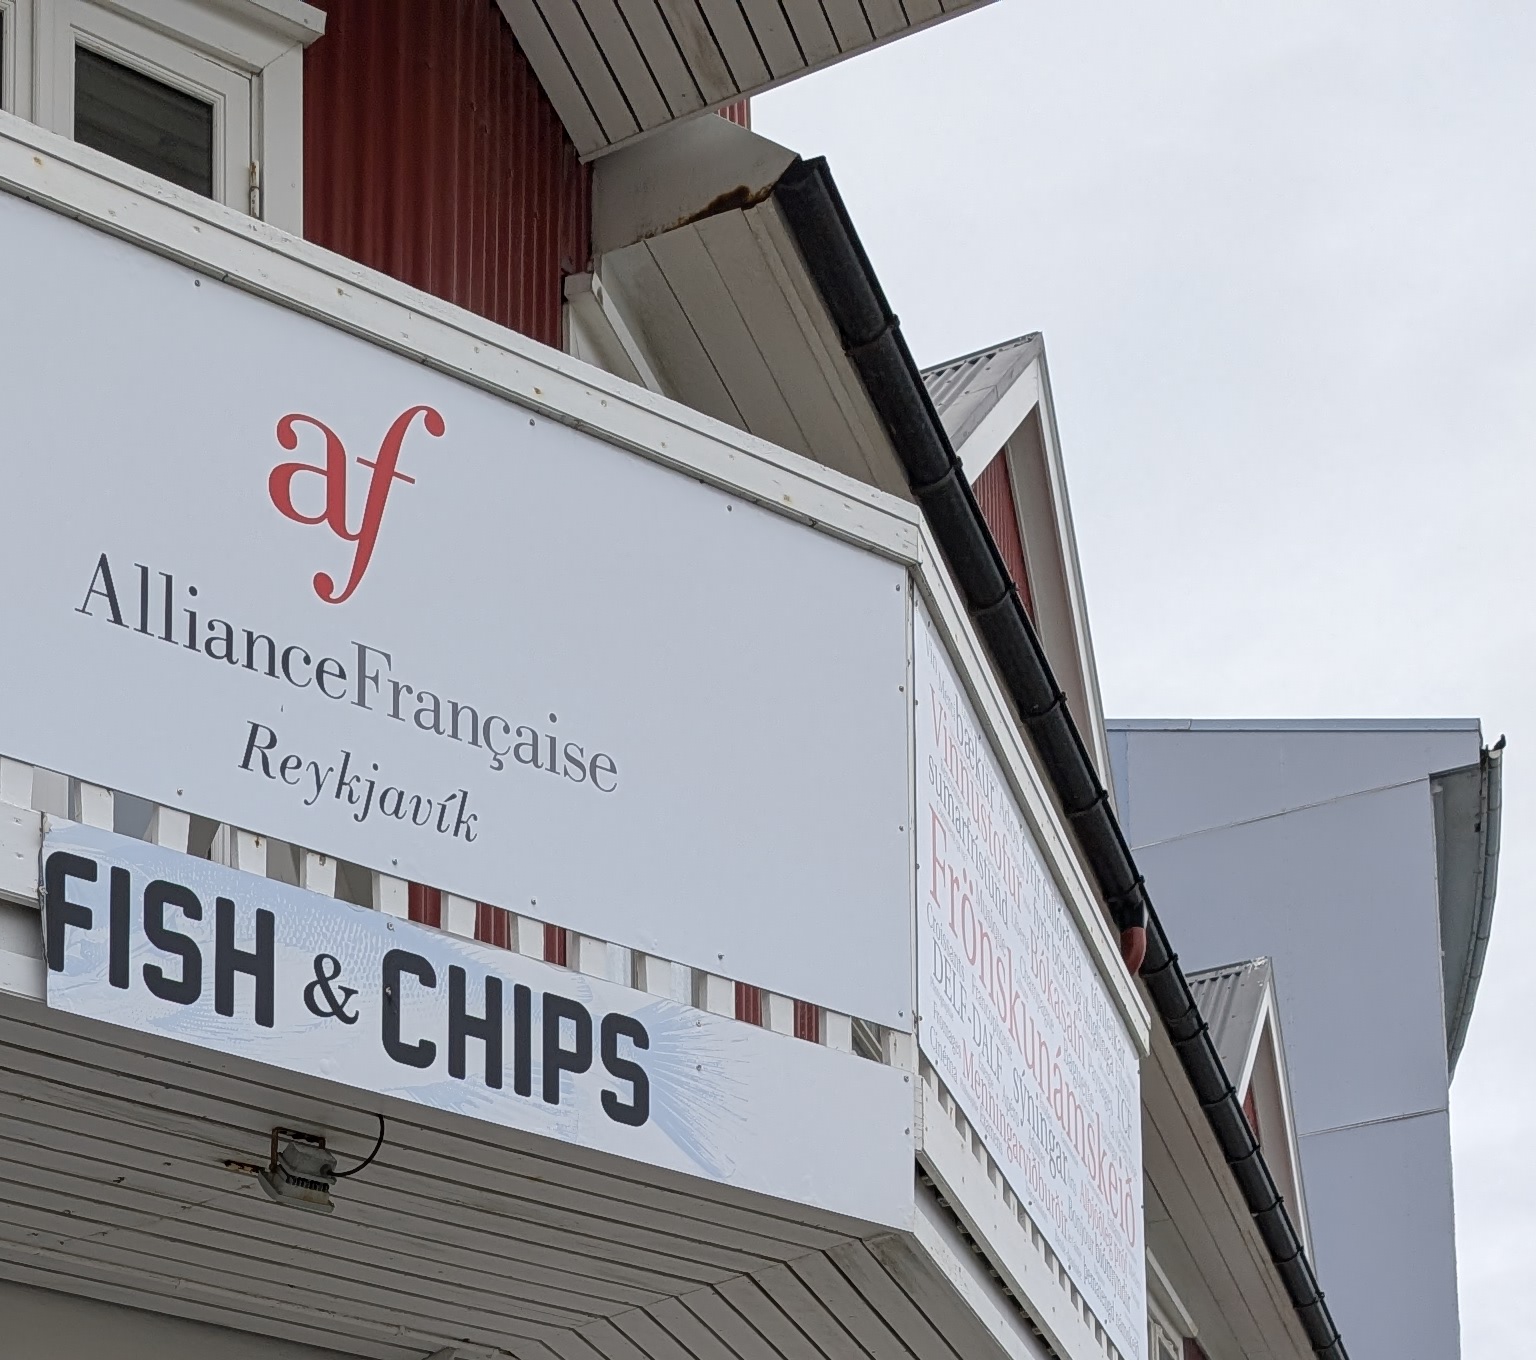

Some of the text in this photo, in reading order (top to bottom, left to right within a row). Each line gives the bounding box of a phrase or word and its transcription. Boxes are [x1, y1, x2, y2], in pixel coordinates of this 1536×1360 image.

[268, 405, 445, 604] af
[238, 720, 479, 843] Reykjavík
[45, 850, 651, 1127] FISH & CHIPS
